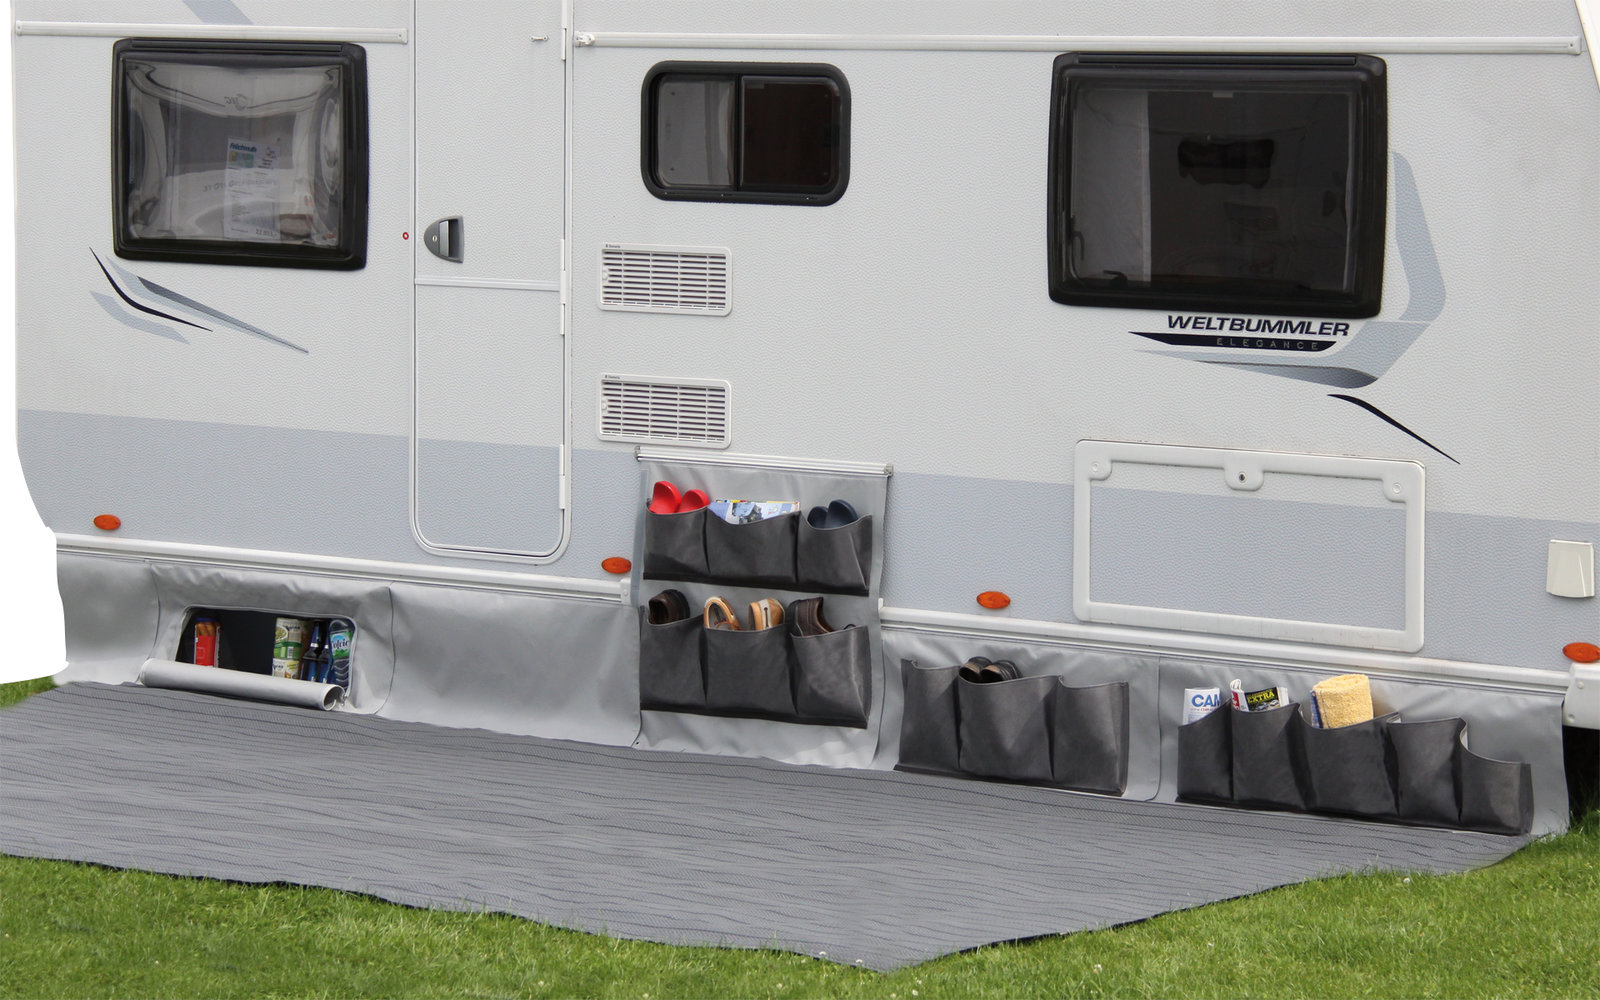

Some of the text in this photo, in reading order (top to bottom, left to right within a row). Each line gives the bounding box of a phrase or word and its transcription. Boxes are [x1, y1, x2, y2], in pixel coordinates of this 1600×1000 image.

[1167, 315, 1350, 336] WELTBUMMLER
[1216, 338, 1319, 351] ELEGANCE
[1247, 691, 1275, 704] EXTRA
